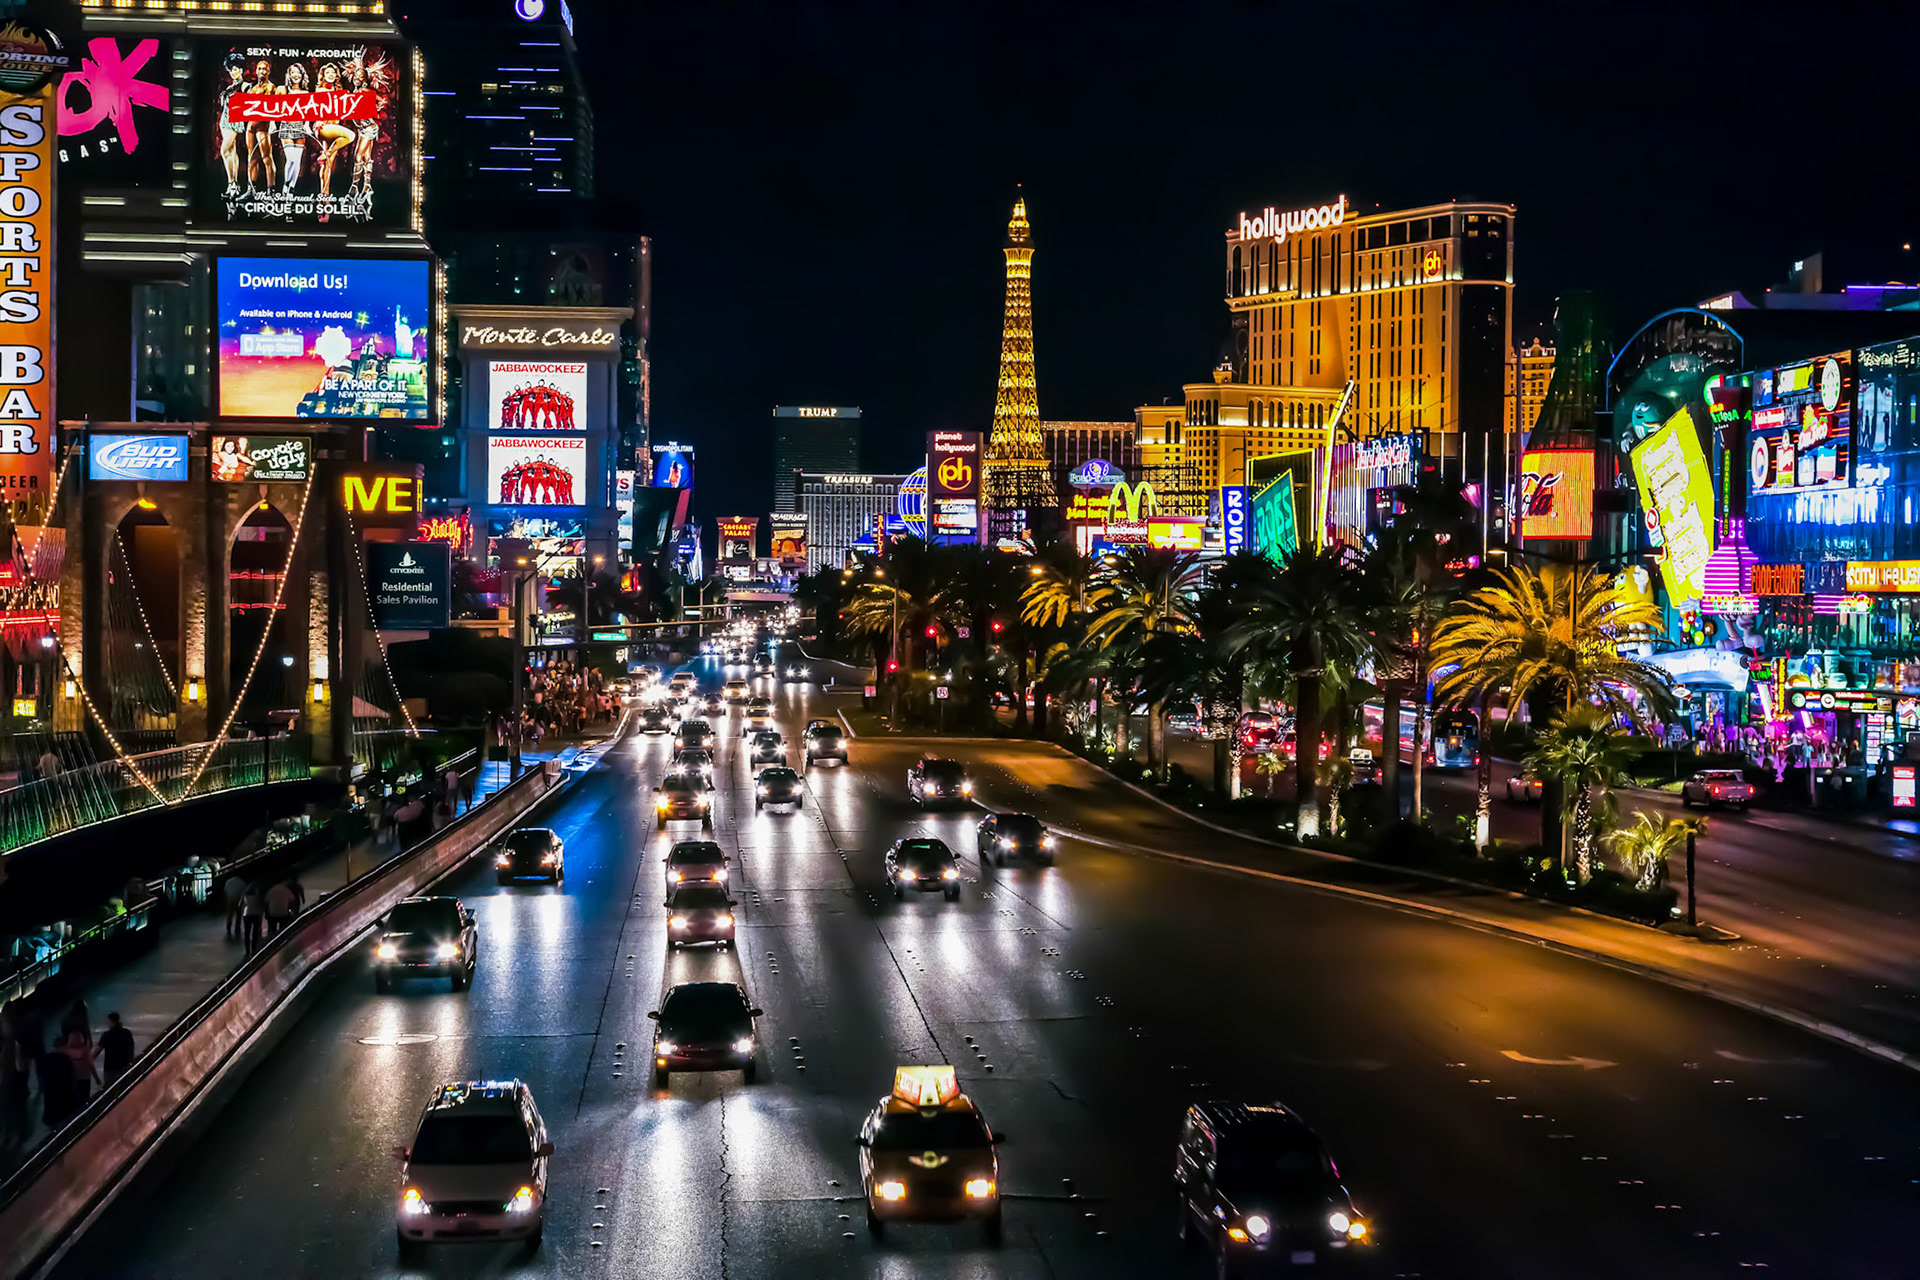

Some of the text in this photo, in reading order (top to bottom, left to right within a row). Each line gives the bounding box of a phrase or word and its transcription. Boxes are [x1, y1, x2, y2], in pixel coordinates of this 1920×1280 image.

[246, 47, 362, 59] SEXY FUN ACROBATIC
[243, 92, 363, 120] ZUMANITY
[254, 192, 272, 202] The
[316, 193, 337, 203] Side
[0, 104, 45, 323] SPORTS
[244, 201, 292, 217] CIRQUE
[294, 203, 314, 215] DU
[1240, 194, 1346, 244] hollywood
[1424, 251, 1442, 277] ph
[239, 272, 348, 290] Download Us!
[239, 309, 353, 319] Available on iPhone & Android
[462, 326, 616, 347] Monte Carlo
[491, 363, 586, 374] JABBAWOCKEEZ
[325, 379, 339, 391] BE
[340, 379, 350, 391] A
[350, 380, 378, 391] PART
[378, 380, 396, 391] OF
[0, 344, 44, 455] BAR
[798, 407, 838, 418] TRUMP
[490, 438, 585, 449] JABBAWOCKEEZ
[934, 432, 963, 442] planet
[119, 444, 178, 457] BUD
[251, 440, 304, 462] coyote
[934, 442, 976, 454] hollywood
[111, 456, 182, 470] LIGHT
[267, 451, 306, 469] ugly
[941, 457, 973, 485] ph
[0, 475, 38, 488] BEER
[823, 475, 873, 484] TREASURE
[938, 527, 971, 535] Panasonic
[1751, 563, 1801, 595] FOOD COURT
[382, 582, 433, 592] Residential
[376, 595, 439, 604] Sales Pavilion
